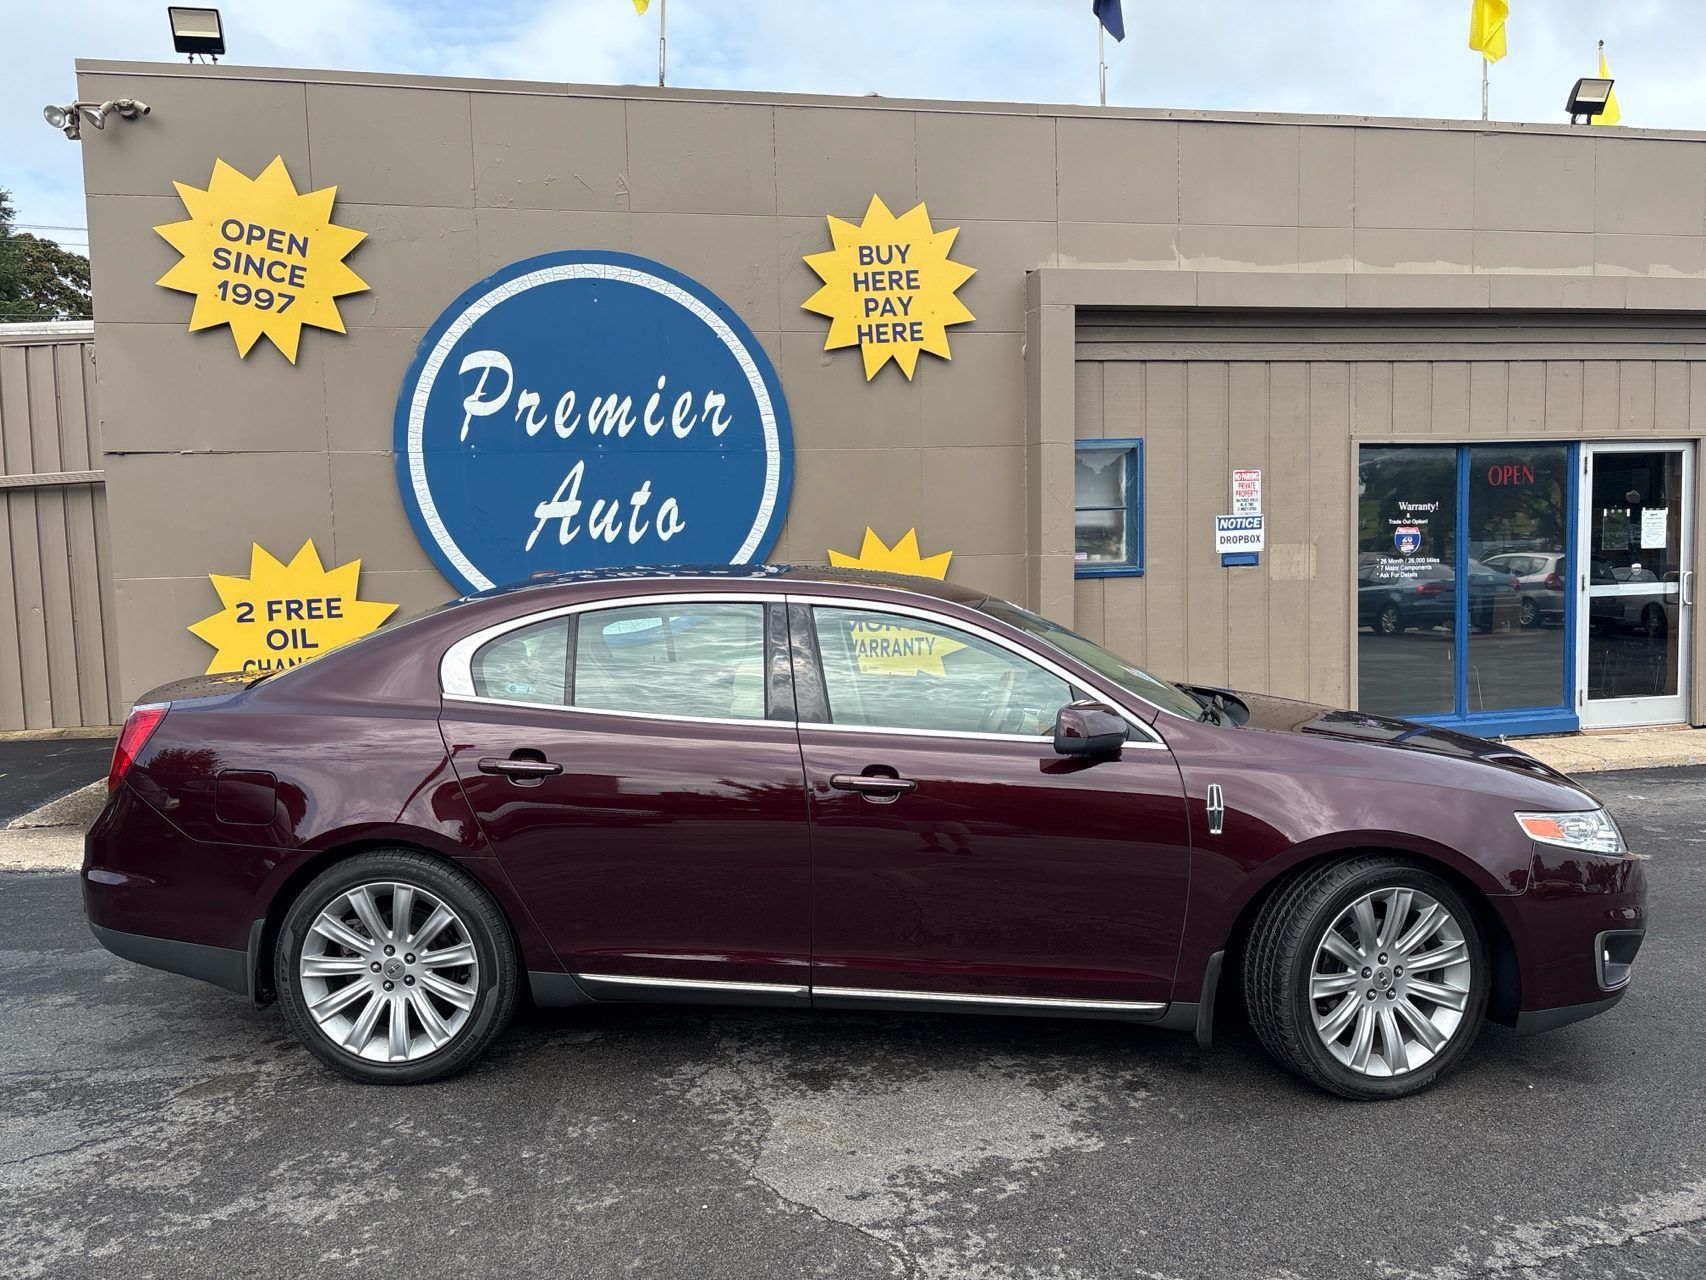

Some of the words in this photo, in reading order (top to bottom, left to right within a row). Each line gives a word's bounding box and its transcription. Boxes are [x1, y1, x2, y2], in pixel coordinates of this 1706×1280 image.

[221, 218, 309, 258] OPEN
[858, 244, 911, 266] BUY
[211, 247, 307, 289] SINCE
[852, 269, 921, 292] HERE
[217, 280, 296, 314] 1997
[864, 296, 913, 318] PAY
[856, 321, 924, 344] HERE
[458, 349, 733, 443] Premier
[1487, 464, 1535, 486] OPEN
[525, 459, 686, 552] Auto
[1398, 501, 1439, 512] Warranty!
[1220, 517, 1261, 530] NOTICE
[1220, 534, 1261, 545] DROPBOX
[235, 602, 255, 623] 2
[267, 597, 343, 621] FREE
[266, 628, 319, 651] OIL
